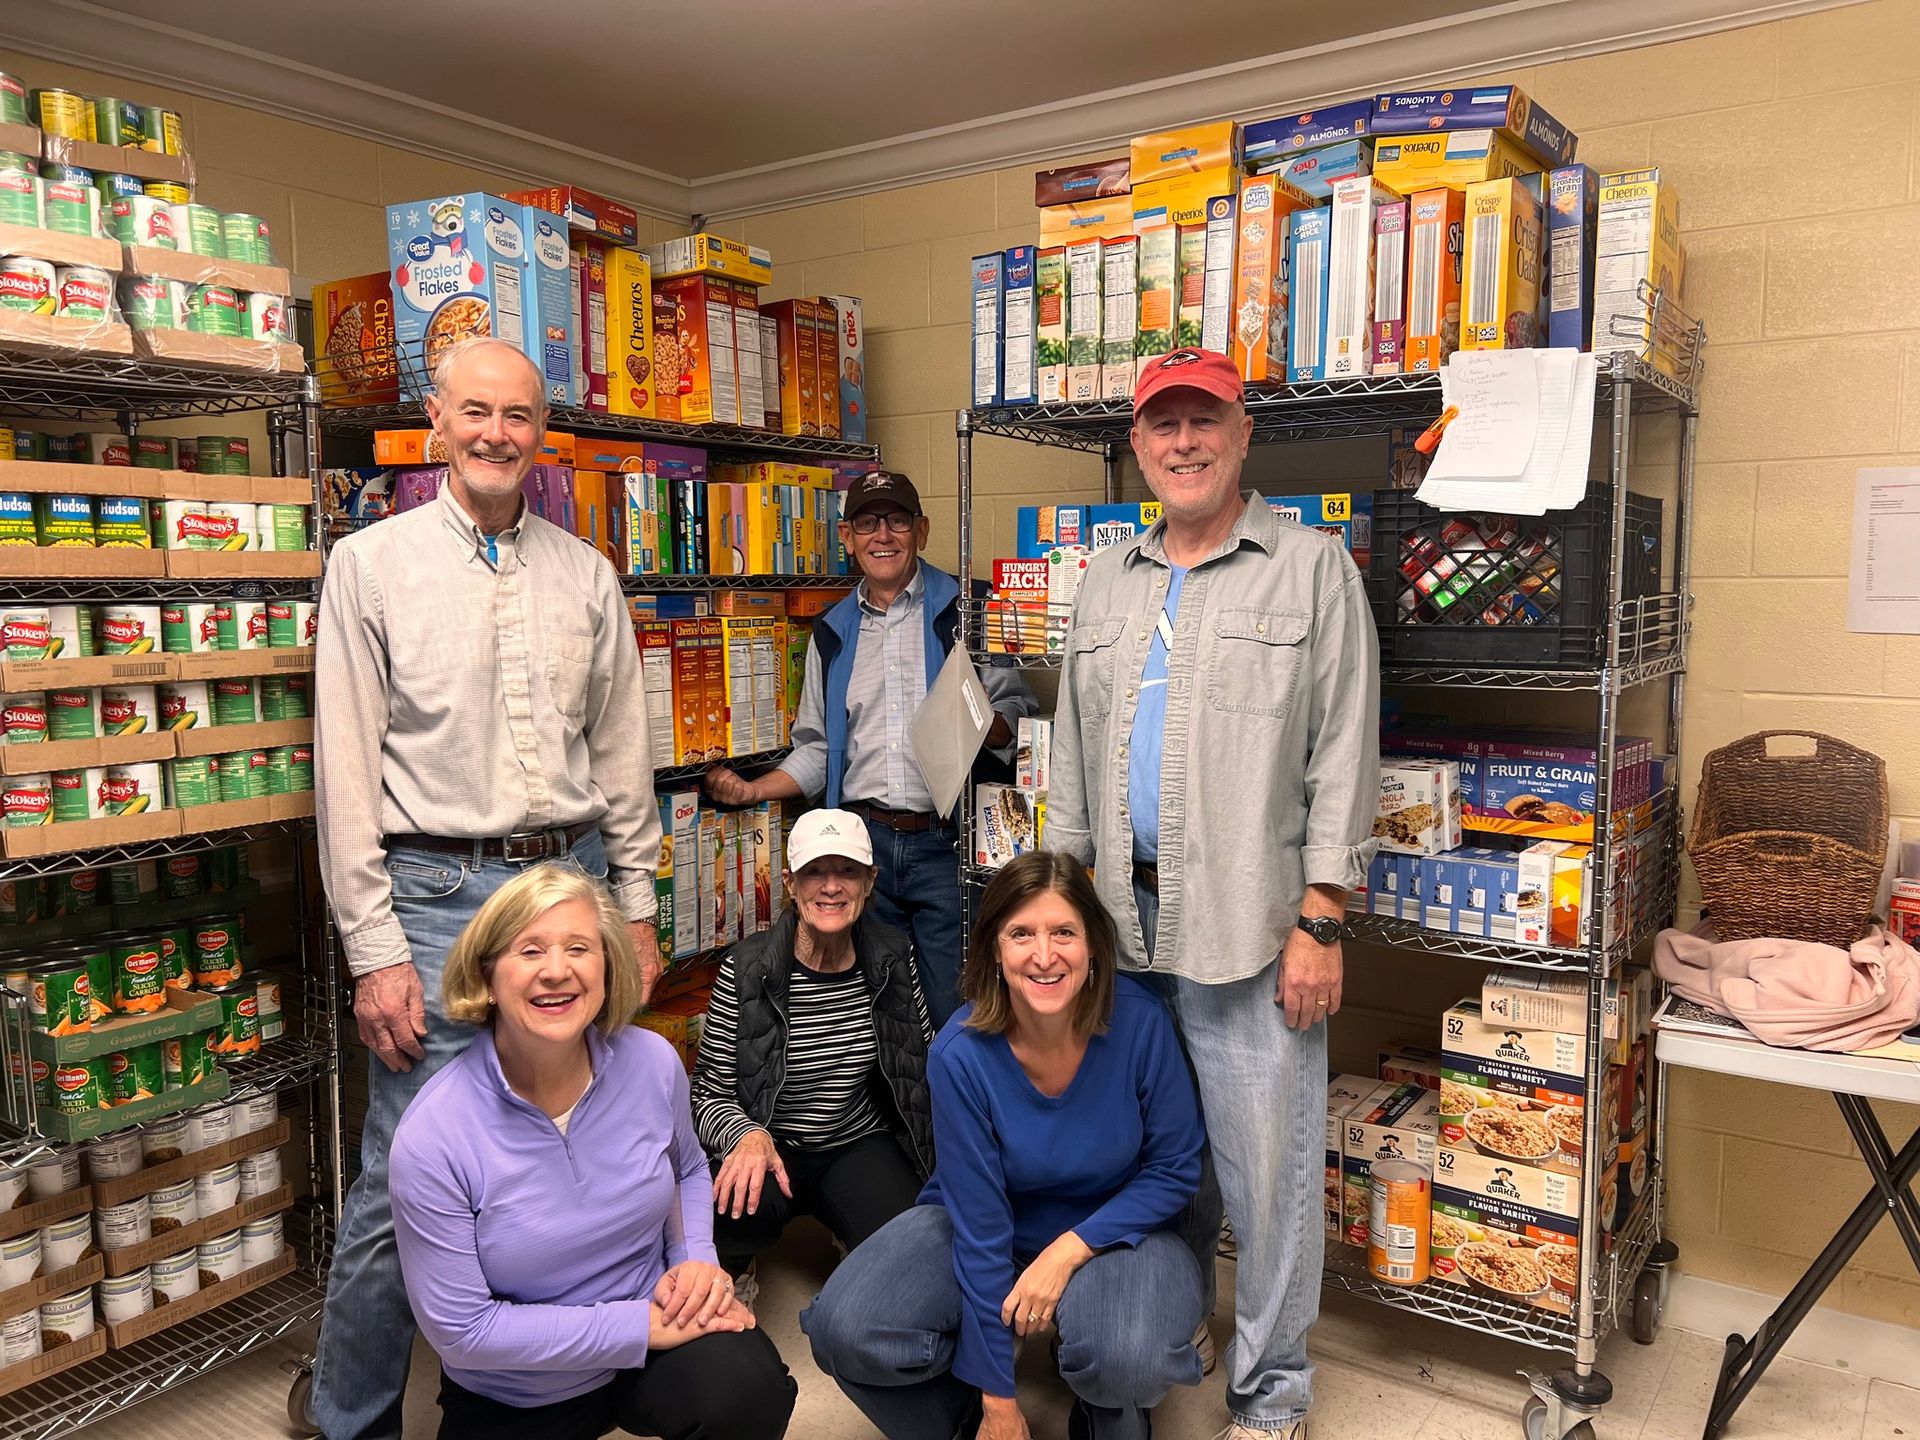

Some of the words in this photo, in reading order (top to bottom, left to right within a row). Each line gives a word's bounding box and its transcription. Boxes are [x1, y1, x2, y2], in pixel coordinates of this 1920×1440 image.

[1395, 95, 1436, 106] ALMONDS
[1309, 127, 1350, 142] ALMONDS
[1529, 117, 1560, 152] ALMONDS
[1404, 140, 1440, 154] Cheerios
[1293, 158, 1318, 174] Chex
[1551, 176, 1582, 189] Frosted
[1556, 183, 1579, 195] Bran
[1245, 191, 1268, 203] Mini
[1278, 178, 1300, 198] FAMILY
[1300, 190, 1316, 208] SIZE
[1605, 185, 1648, 201] Cheerios
[1475, 195, 1502, 207] Crispy
[1172, 208, 1204, 223] Cheerios
[1477, 206, 1497, 215] Oats
[599, 220, 622, 236] Cheerios
[1294, 219, 1323, 236] CRISPY
[1381, 216, 1401, 226] Raisin
[1382, 222, 1399, 231] Bran
[492, 226, 518, 241] Frosted
[1300, 228, 1320, 240] RICE
[409, 240, 430, 252] Great
[495, 236, 517, 251] Flakes
[541, 240, 564, 255] Frosted
[414, 249, 430, 257] Value
[543, 249, 563, 263] Flakes
[414, 261, 463, 281] Frosted
[1516, 248, 1536, 285] Oats
[419, 279, 459, 297] Flakes
[708, 290, 729, 303] Cheerios
[737, 297, 756, 310] Cheerios
[630, 282, 645, 352] Cheerios
[795, 305, 815, 318] Cheerios
[816, 309, 837, 322] Cheerios
[846, 310, 858, 348] Chex
[52, 498, 91, 514] Hudson
[100, 501, 140, 516] Hudson
[1327, 501, 1345, 515] 64
[1144, 508, 1158, 520] 64
[630, 508, 641, 541] LARGE
[1096, 526, 1132, 540] NUTRI
[632, 543, 642, 566] SIZE
[1001, 562, 1048, 573] HUNGRY
[999, 573, 1048, 589] JACK
[676, 626, 699, 637] Cheerios
[700, 625, 722, 636] Cheerios
[730, 628, 750, 638] Cheerios
[753, 627, 772, 637] Cheerios
[646, 634, 667, 647] Cheerios
[1406, 740, 1425, 748] Mixed
[1425, 741, 1444, 750] Berry
[1467, 742, 1479, 753] 8g
[1488, 743, 1495, 752] 8
[1523, 749, 1544, 757] Mixed
[1545, 750, 1565, 760] Berry
[1489, 764, 1532, 777] FRUIT
[1534, 766, 1548, 779] &
[1550, 767, 1596, 785] GRAIN
[1490, 791, 1497, 800] 9
[675, 805, 695, 820] Chex
[1381, 802, 1401, 812] BARS
[991, 804, 1006, 855] GRANOLA
[208, 935, 226, 943] Monte
[127, 960, 139, 968] Del
[139, 957, 157, 967] Monte
[199, 963, 229, 971] CARROTS
[202, 957, 225, 965] SLICED
[128, 986, 160, 997] CARROTS
[133, 981, 157, 989] SLICED
[152, 1023, 177, 1036] Good
[1447, 1018, 1464, 1036] 52
[1495, 1049, 1531, 1063] QUAKER
[1477, 1065, 1509, 1078] FLAVOR
[1511, 1071, 1548, 1086] VARIETY
[1485, 1061, 1510, 1070] INSTANT
[1511, 1066, 1540, 1076] OATMEAL
[56, 1075, 67, 1083] Del
[67, 1073, 87, 1082] Monte
[60, 1099, 86, 1108] SLICED
[162, 1096, 185, 1110] Good
[1350, 1128, 1364, 1143] 52
[1439, 1152, 1455, 1170] 52
[1486, 1184, 1521, 1200] QUAKER
[1468, 1200, 1499, 1214] FLAVOR
[1501, 1208, 1538, 1223] VARIETY
[1476, 1196, 1501, 1206] INSTANT
[1502, 1202, 1530, 1213] OATMEAL
